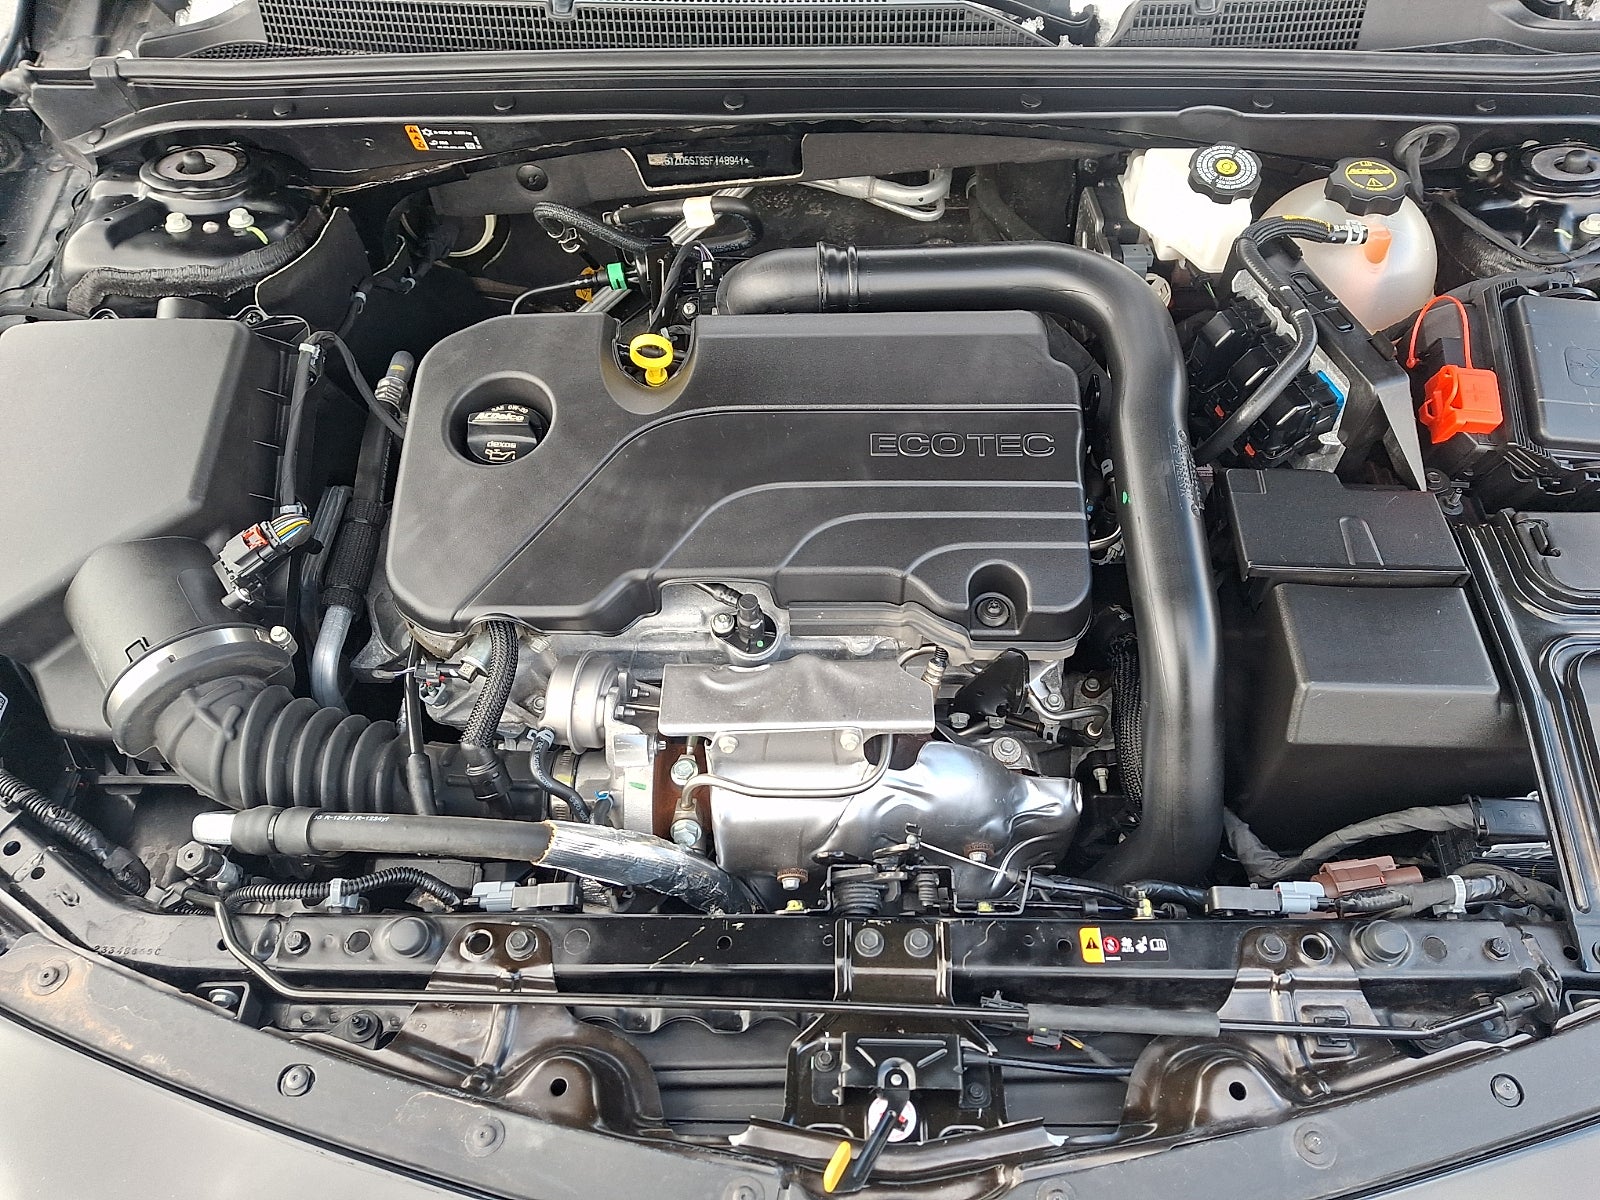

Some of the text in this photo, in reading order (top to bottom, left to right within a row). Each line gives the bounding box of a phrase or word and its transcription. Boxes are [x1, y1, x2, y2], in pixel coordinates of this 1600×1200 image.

[474, 412, 525, 423] ACDelco
[486, 440, 517, 449] dexos
[869, 432, 1056, 457] ECOTEC
